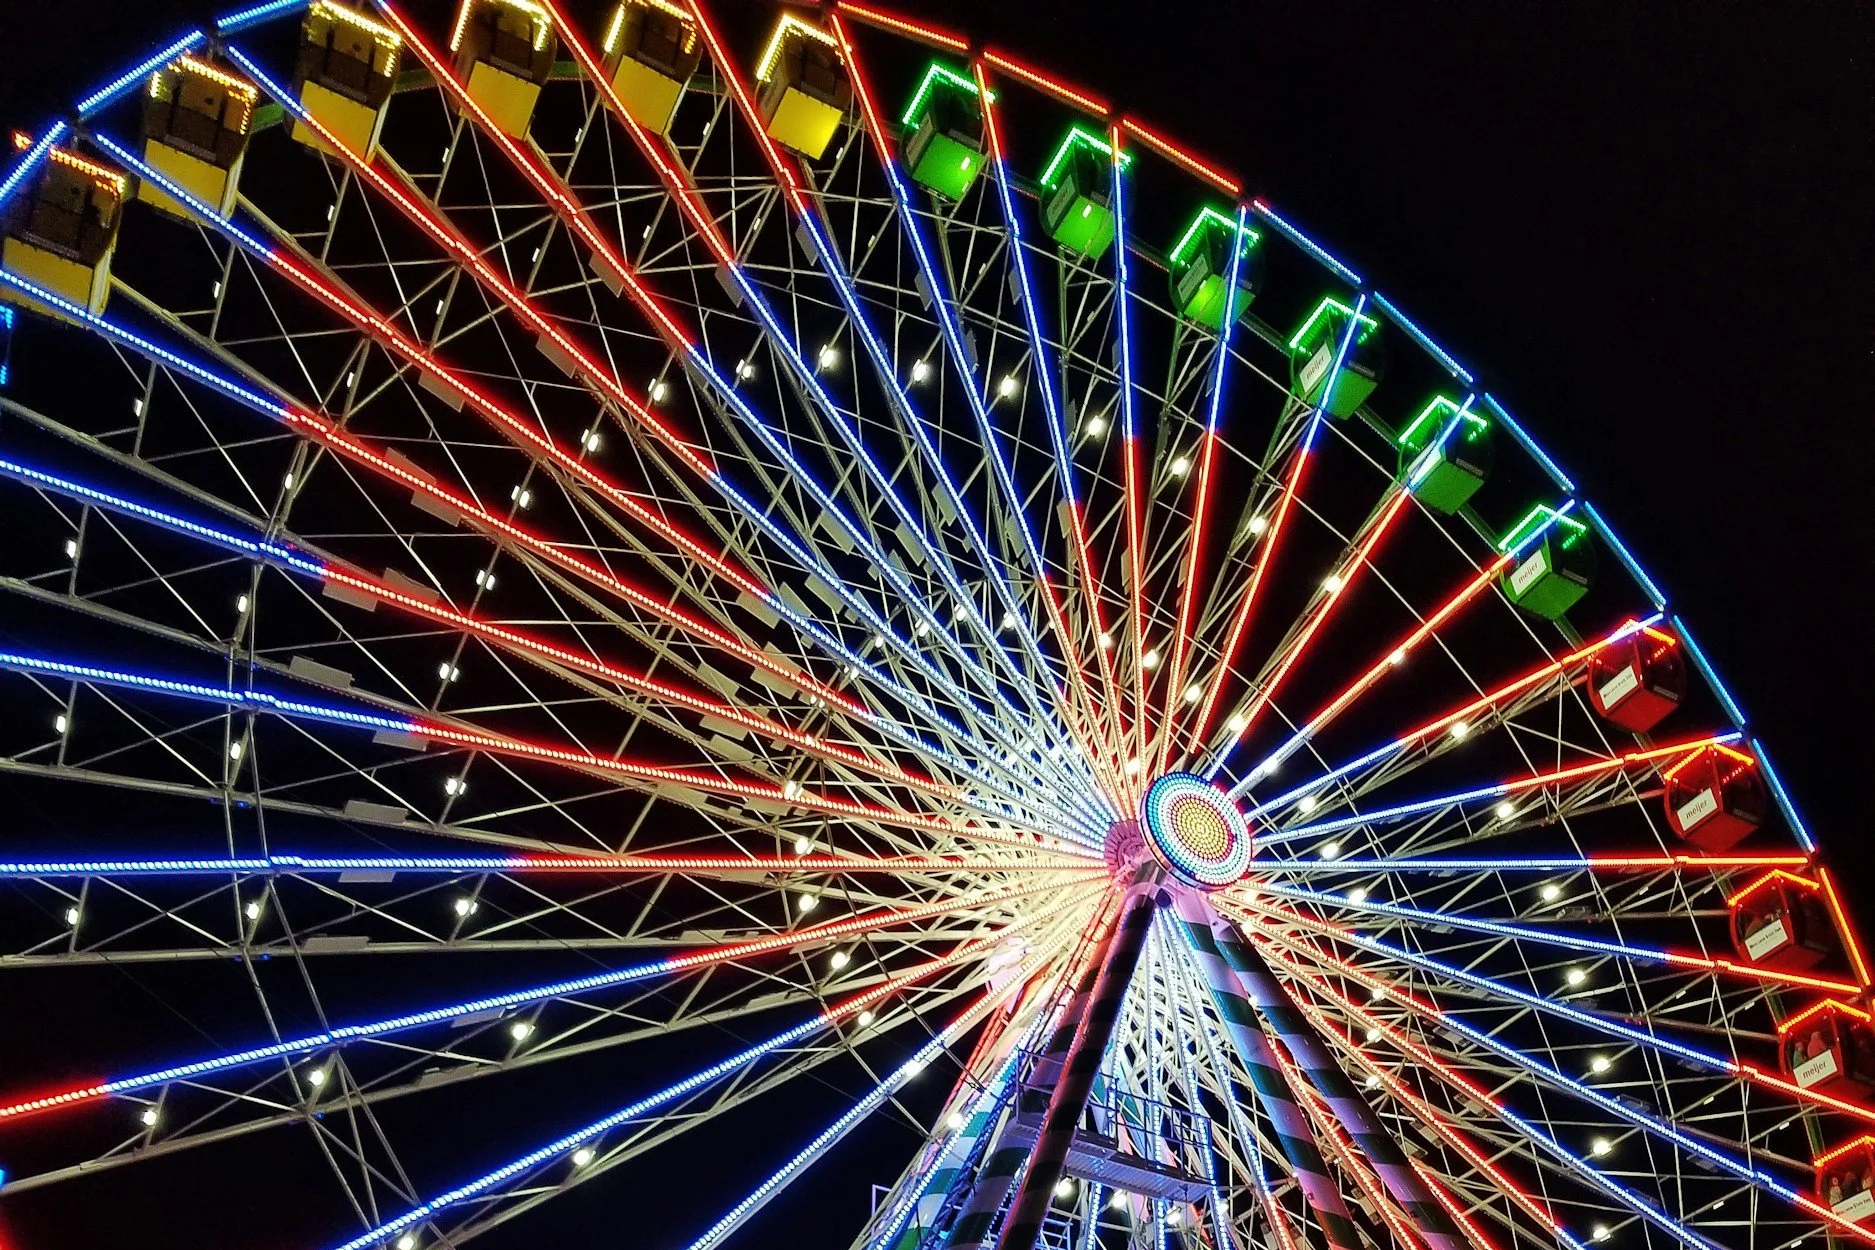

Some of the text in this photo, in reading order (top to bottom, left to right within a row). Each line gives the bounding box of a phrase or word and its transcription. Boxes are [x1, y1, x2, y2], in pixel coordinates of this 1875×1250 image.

[1306, 356, 1325, 380] meijer
[1518, 561, 1539, 584] meijer
[1685, 799, 1708, 820] meijer
[1802, 1061, 1827, 1079] meijer
